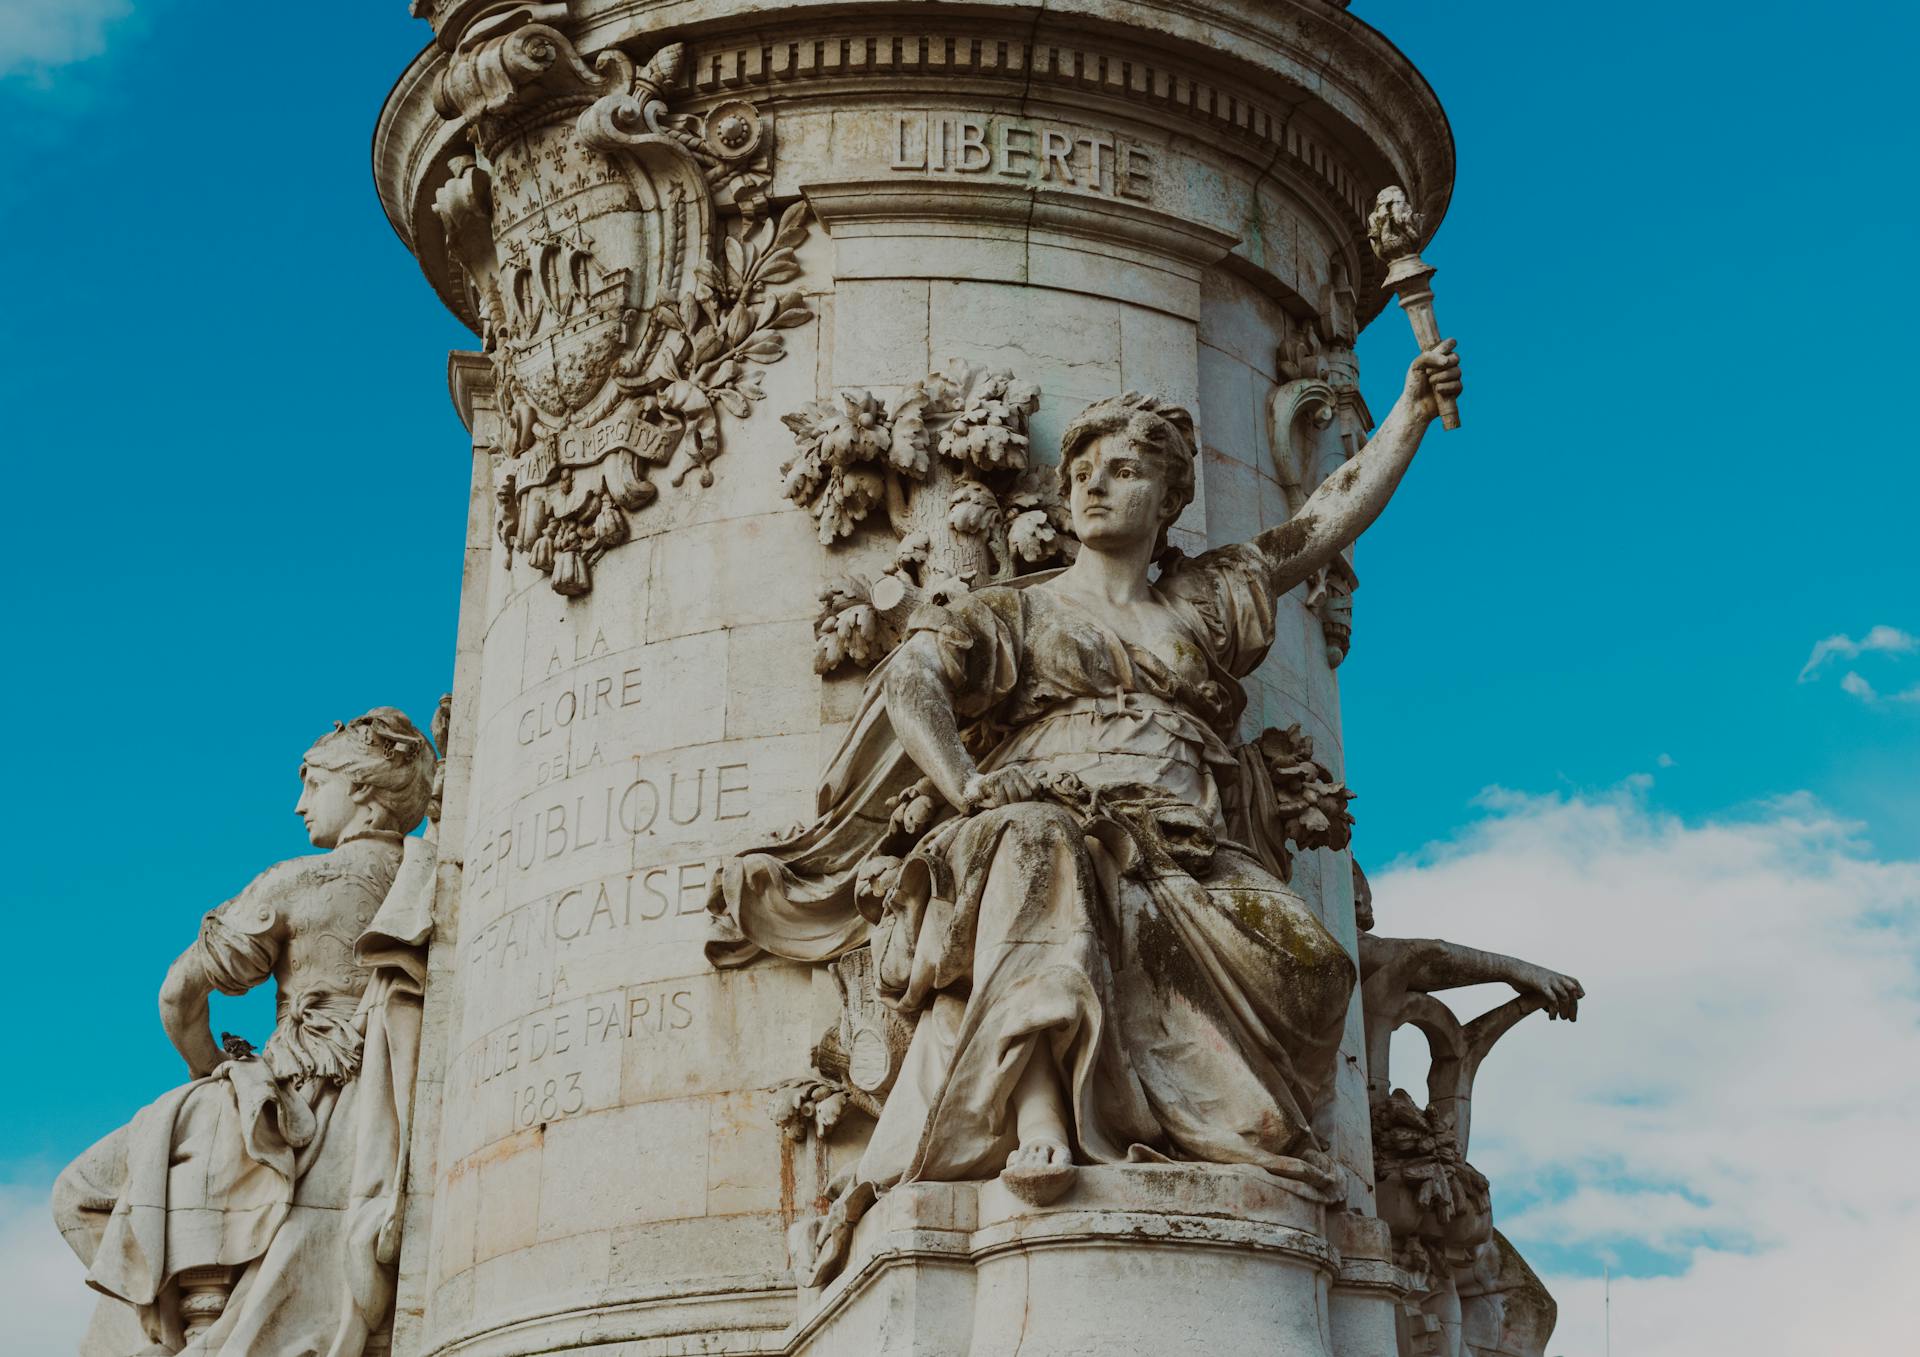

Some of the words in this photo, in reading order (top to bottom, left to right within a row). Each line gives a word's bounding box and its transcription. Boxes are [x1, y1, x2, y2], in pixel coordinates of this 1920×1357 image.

[890, 117, 1151, 200] LIBERTE
[546, 644, 563, 675] A
[573, 626, 610, 661] LA
[517, 667, 642, 746] GLOIRE
[536, 754, 565, 787] DE
[575, 741, 605, 770] LA
[536, 964, 570, 1000] LA
[529, 1014, 572, 1063] DE
[584, 991, 693, 1046] PARIS
[511, 1070, 585, 1133] 1883
